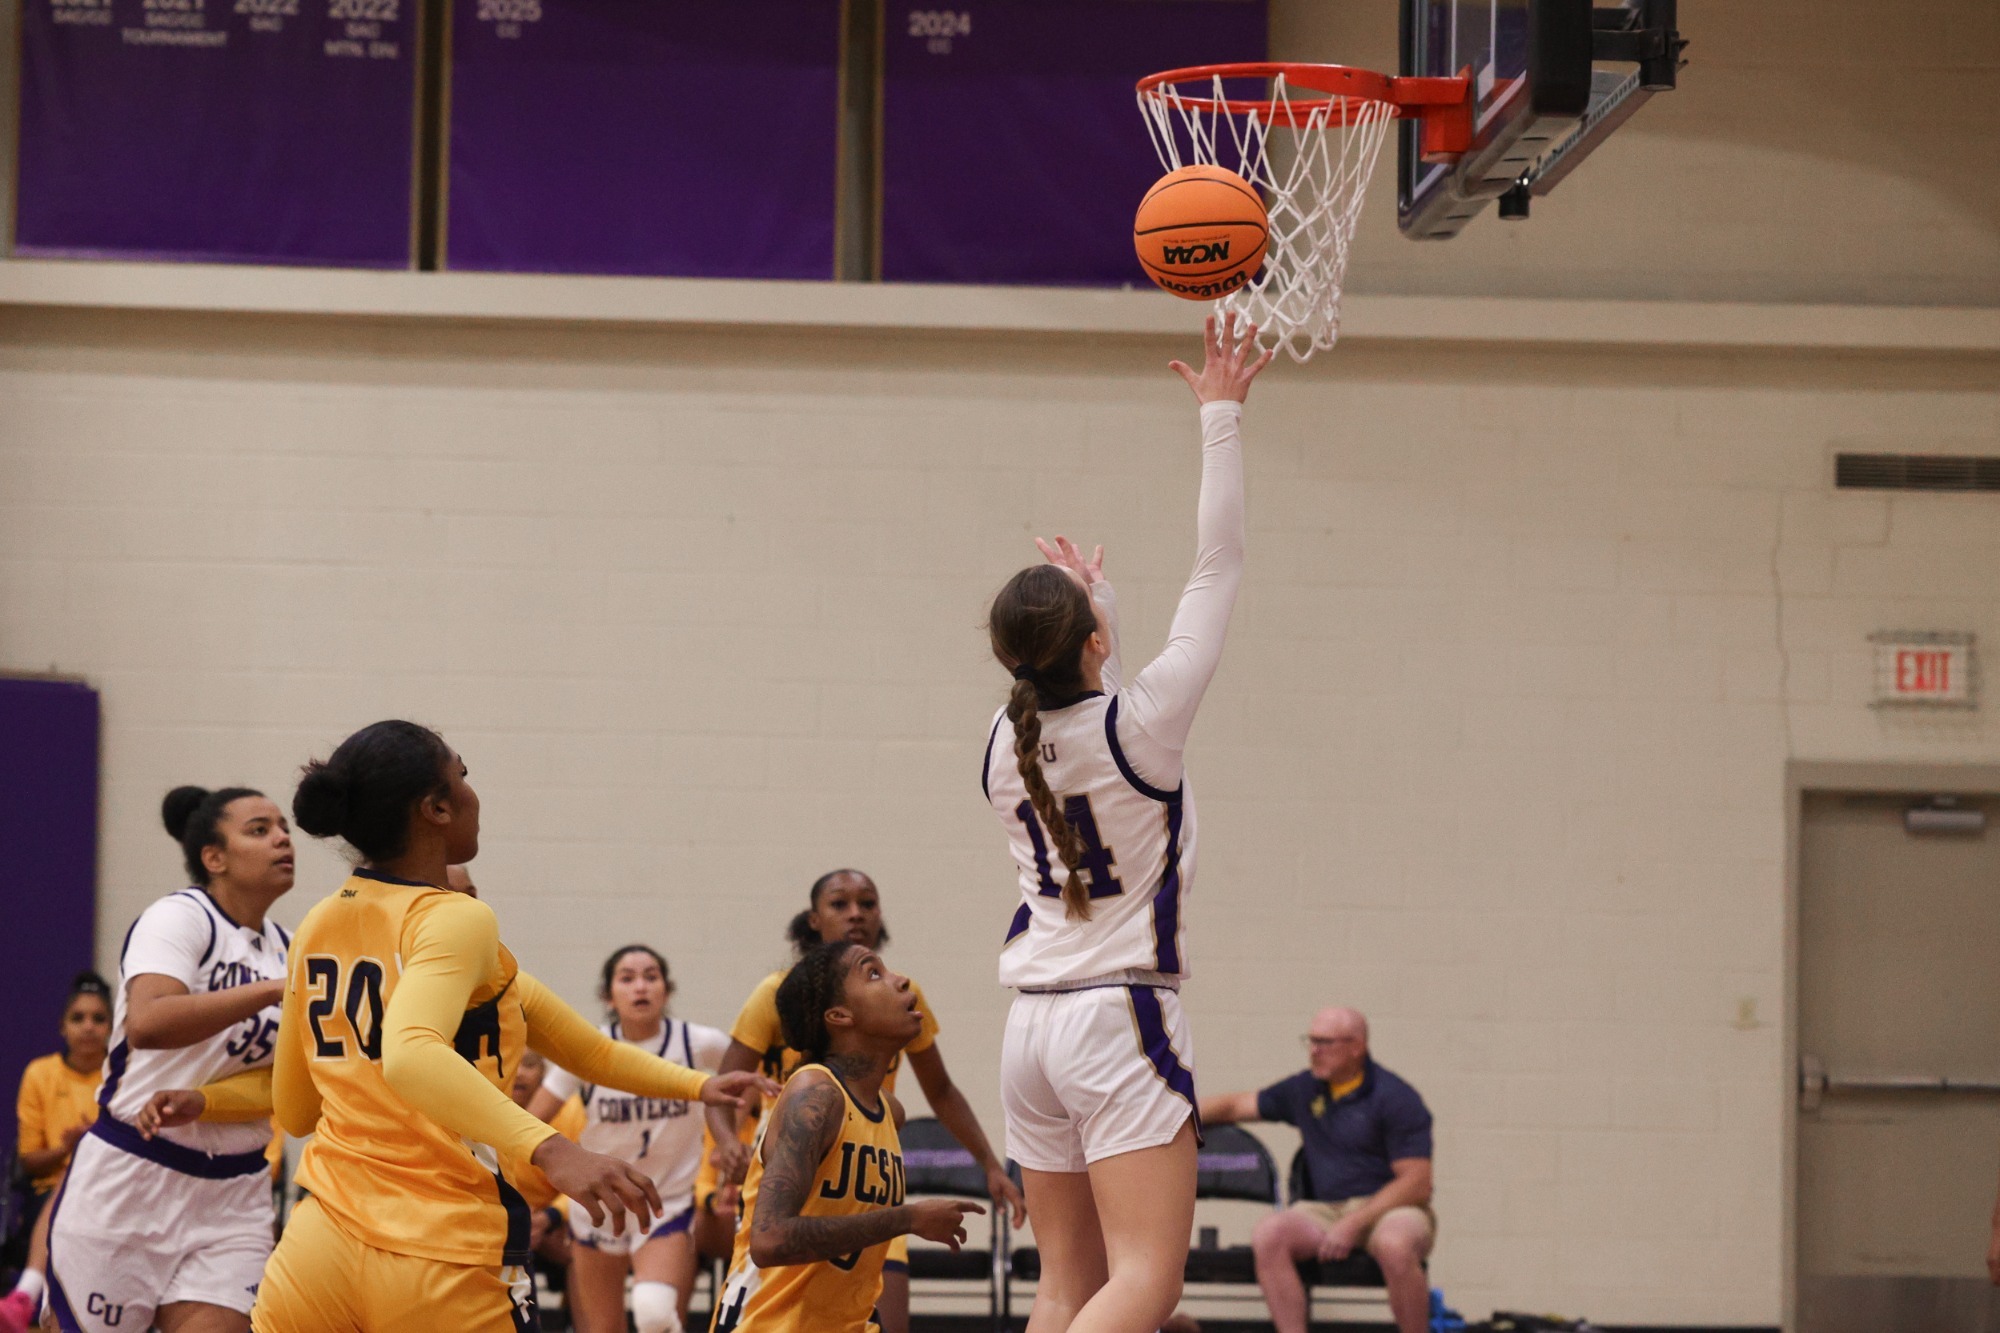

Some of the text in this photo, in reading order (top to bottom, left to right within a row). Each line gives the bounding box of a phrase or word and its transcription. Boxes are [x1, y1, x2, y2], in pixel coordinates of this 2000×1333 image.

[328, 0, 398, 20] 2022
[908, 10, 971, 37] 2024
[1163, 241, 1230, 265] NCAA
[1158, 270, 1247, 297] Wilson
[1896, 650, 1951, 692] EXIT
[1014, 792, 1125, 899] 14
[304, 953, 386, 1064] 20
[226, 1014, 279, 1065] 35
[638, 1129, 651, 1158] 1
[86, 1292, 123, 1327] CU
